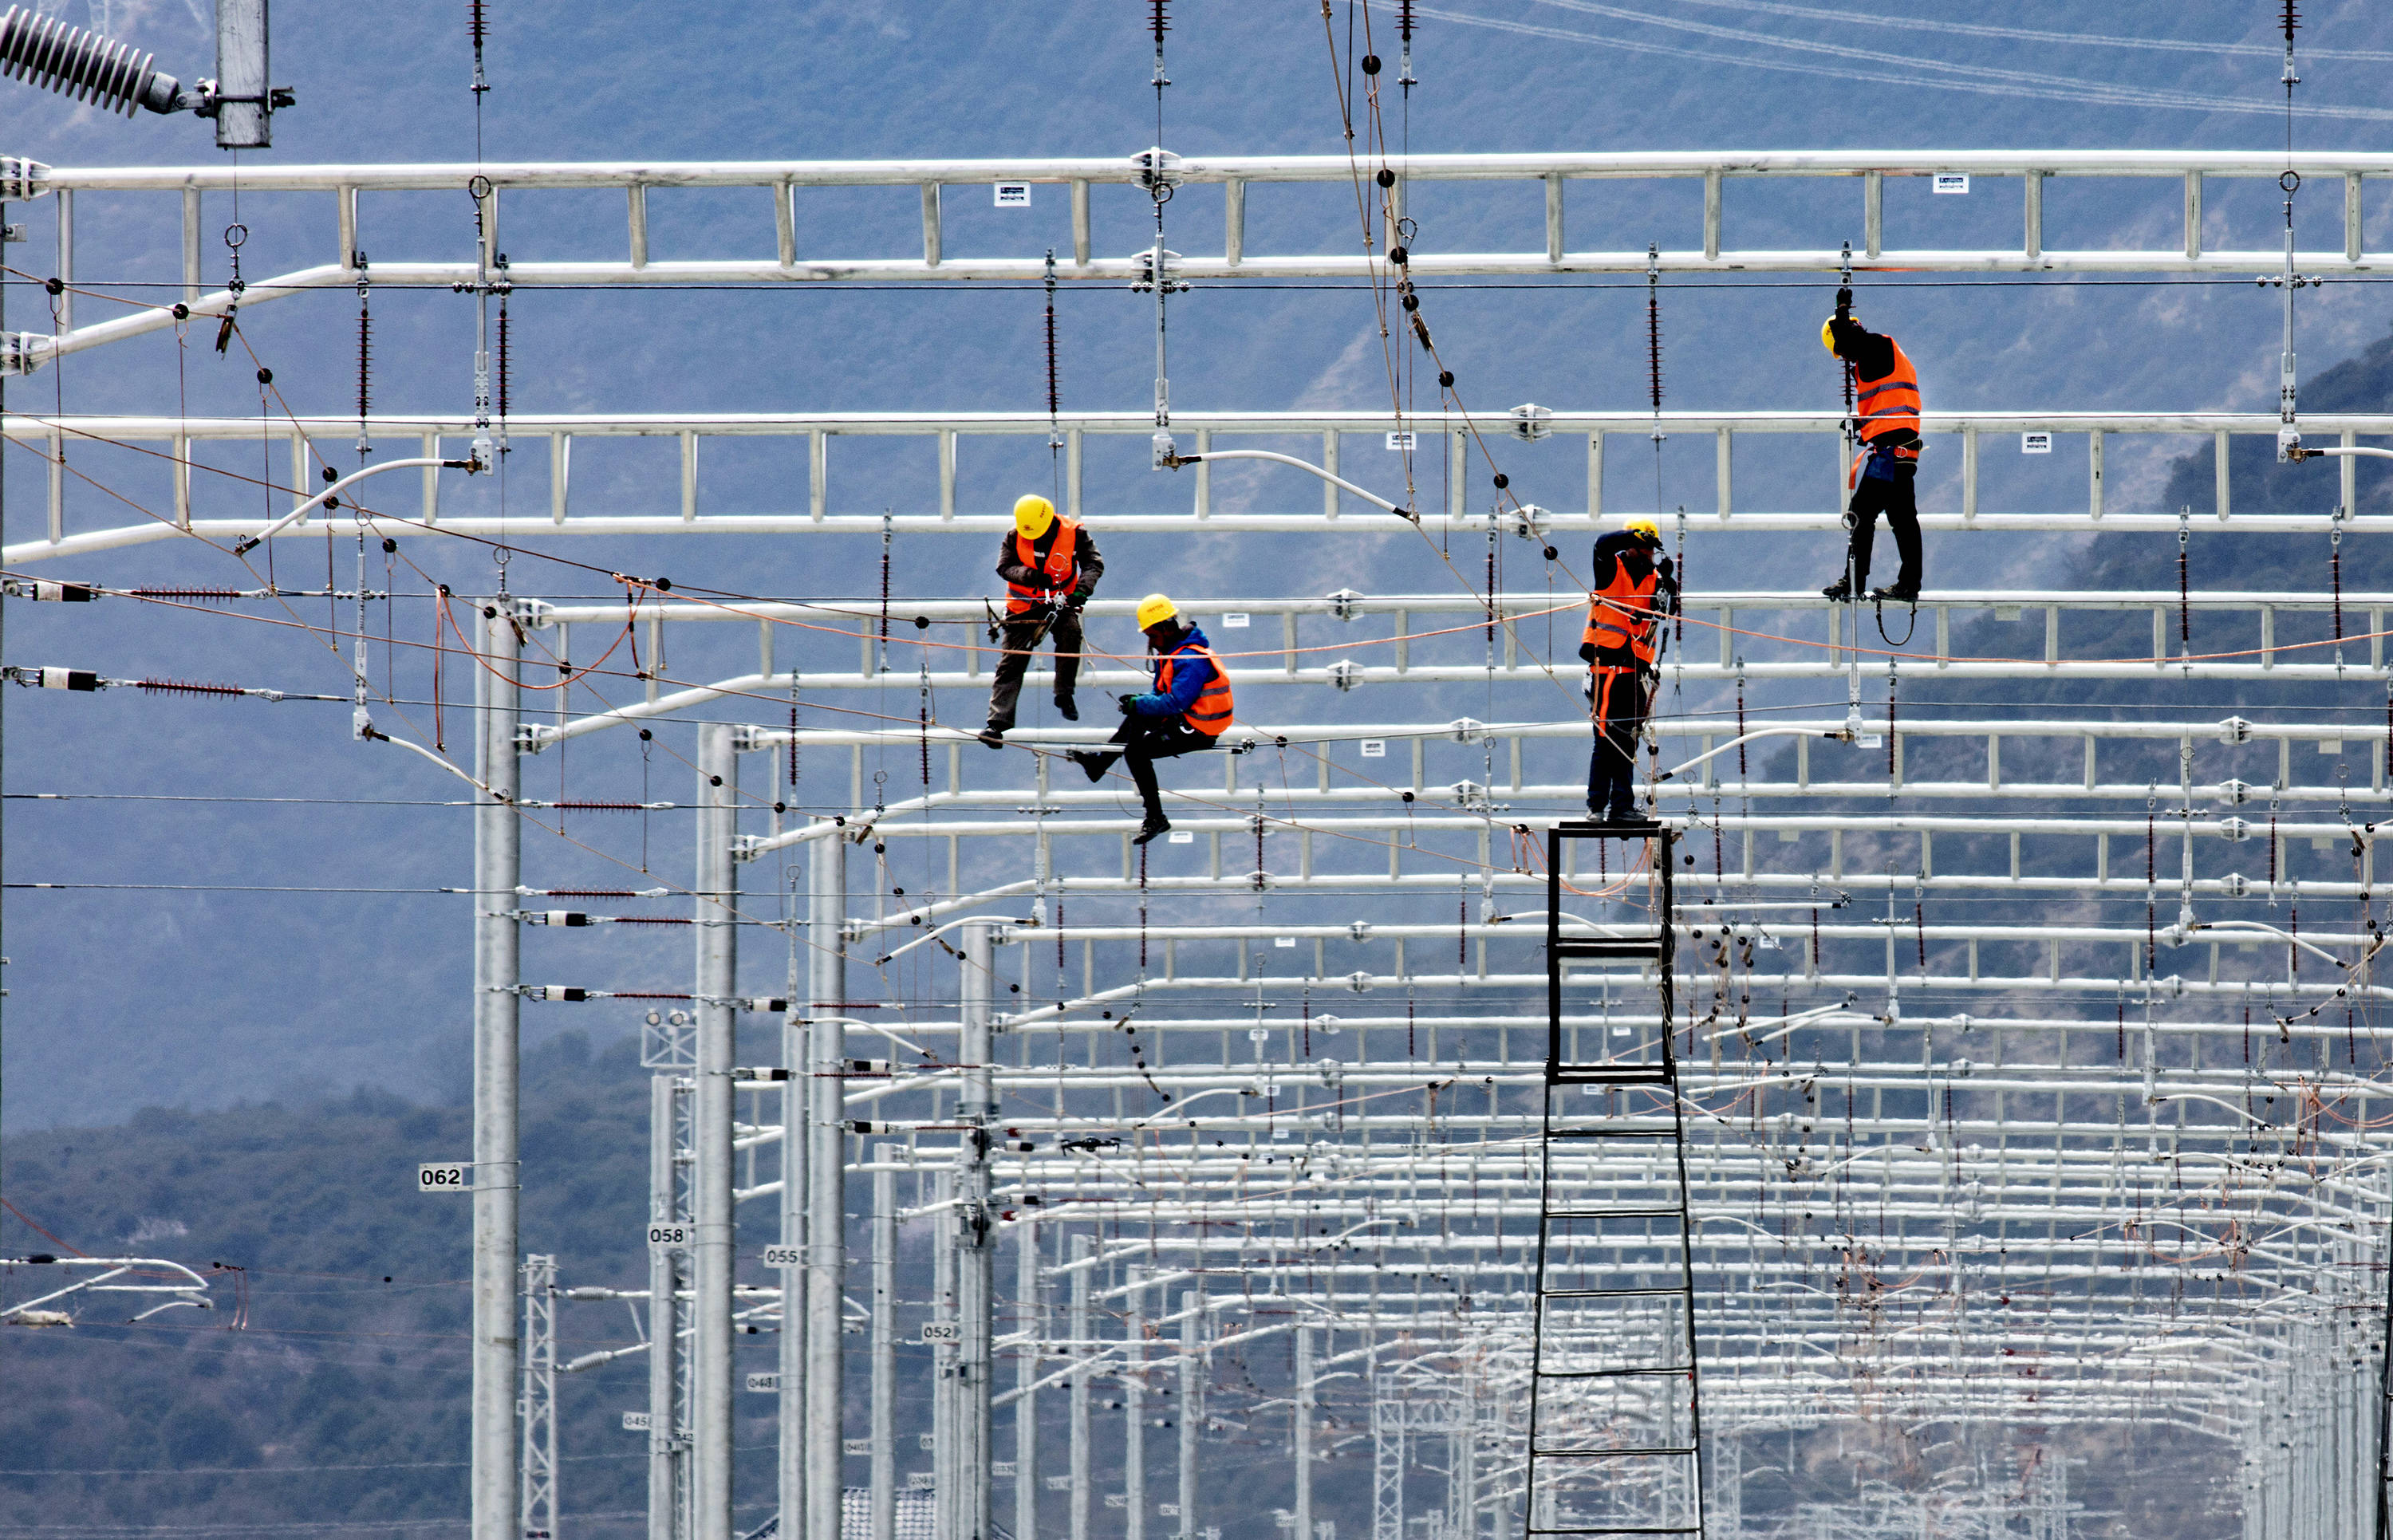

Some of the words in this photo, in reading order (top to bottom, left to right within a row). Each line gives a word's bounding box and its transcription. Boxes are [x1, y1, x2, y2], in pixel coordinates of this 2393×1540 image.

[422, 1169, 459, 1185] 062
[651, 1229, 684, 1243] 058
[767, 1251, 798, 1263] 055
[924, 1327, 952, 1338] 052
